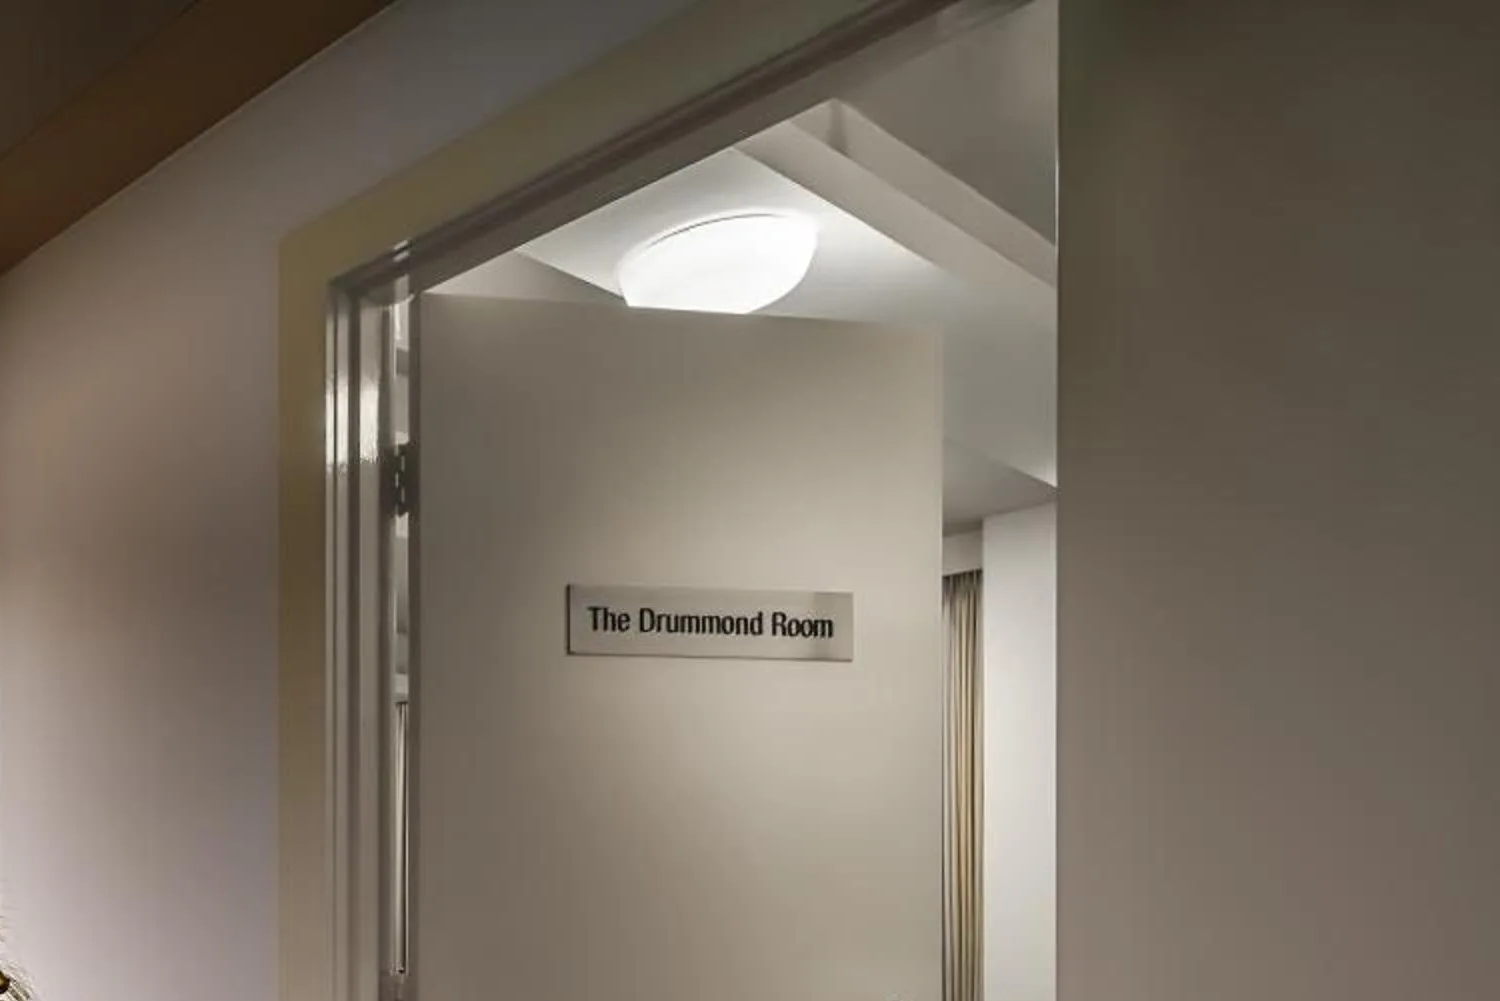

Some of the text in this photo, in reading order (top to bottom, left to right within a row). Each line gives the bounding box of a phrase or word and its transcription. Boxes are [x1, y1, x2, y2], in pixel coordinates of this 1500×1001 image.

[588, 606, 834, 638] The Drummond Room
